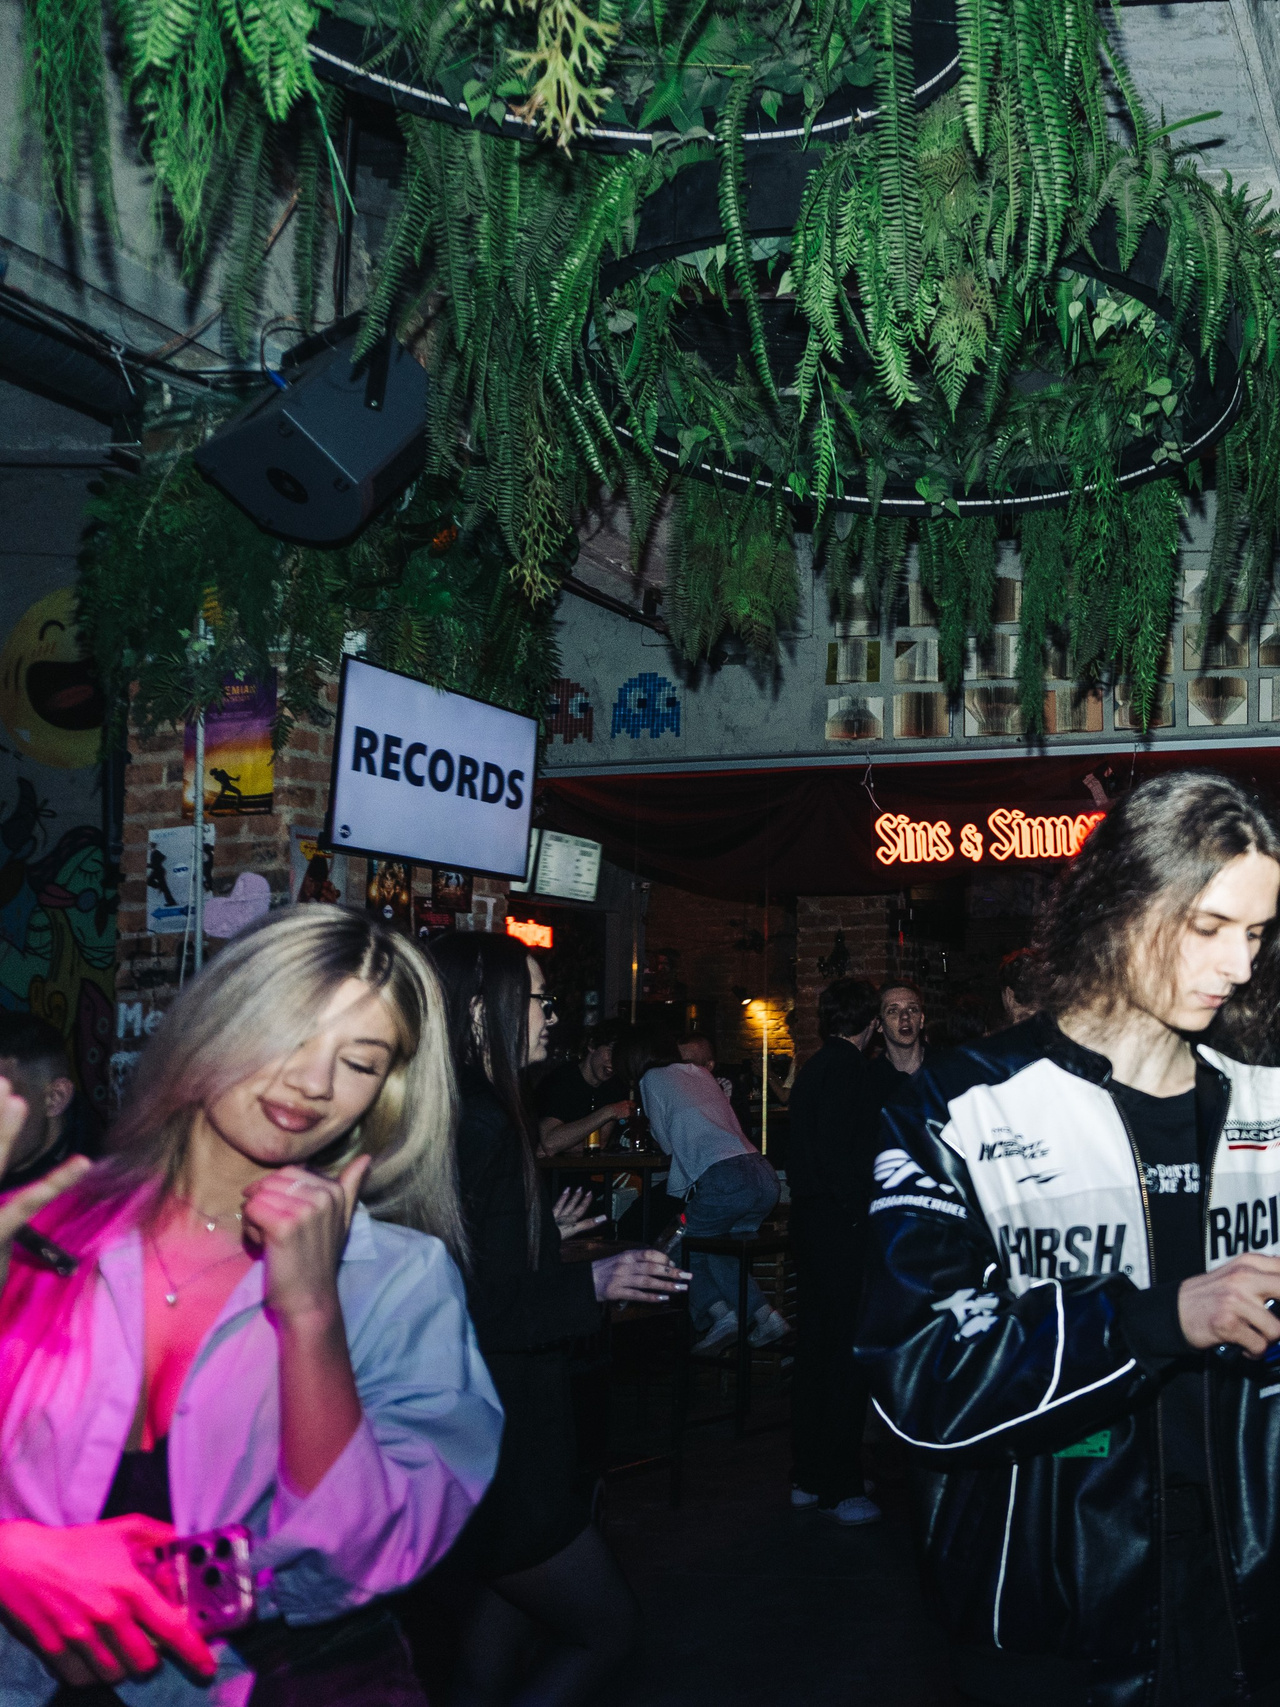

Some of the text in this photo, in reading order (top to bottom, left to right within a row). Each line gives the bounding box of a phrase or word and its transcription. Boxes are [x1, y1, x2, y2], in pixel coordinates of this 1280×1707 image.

[351, 725, 525, 810] RECORDS
[875, 808, 1106, 865] Sins & Sinne
